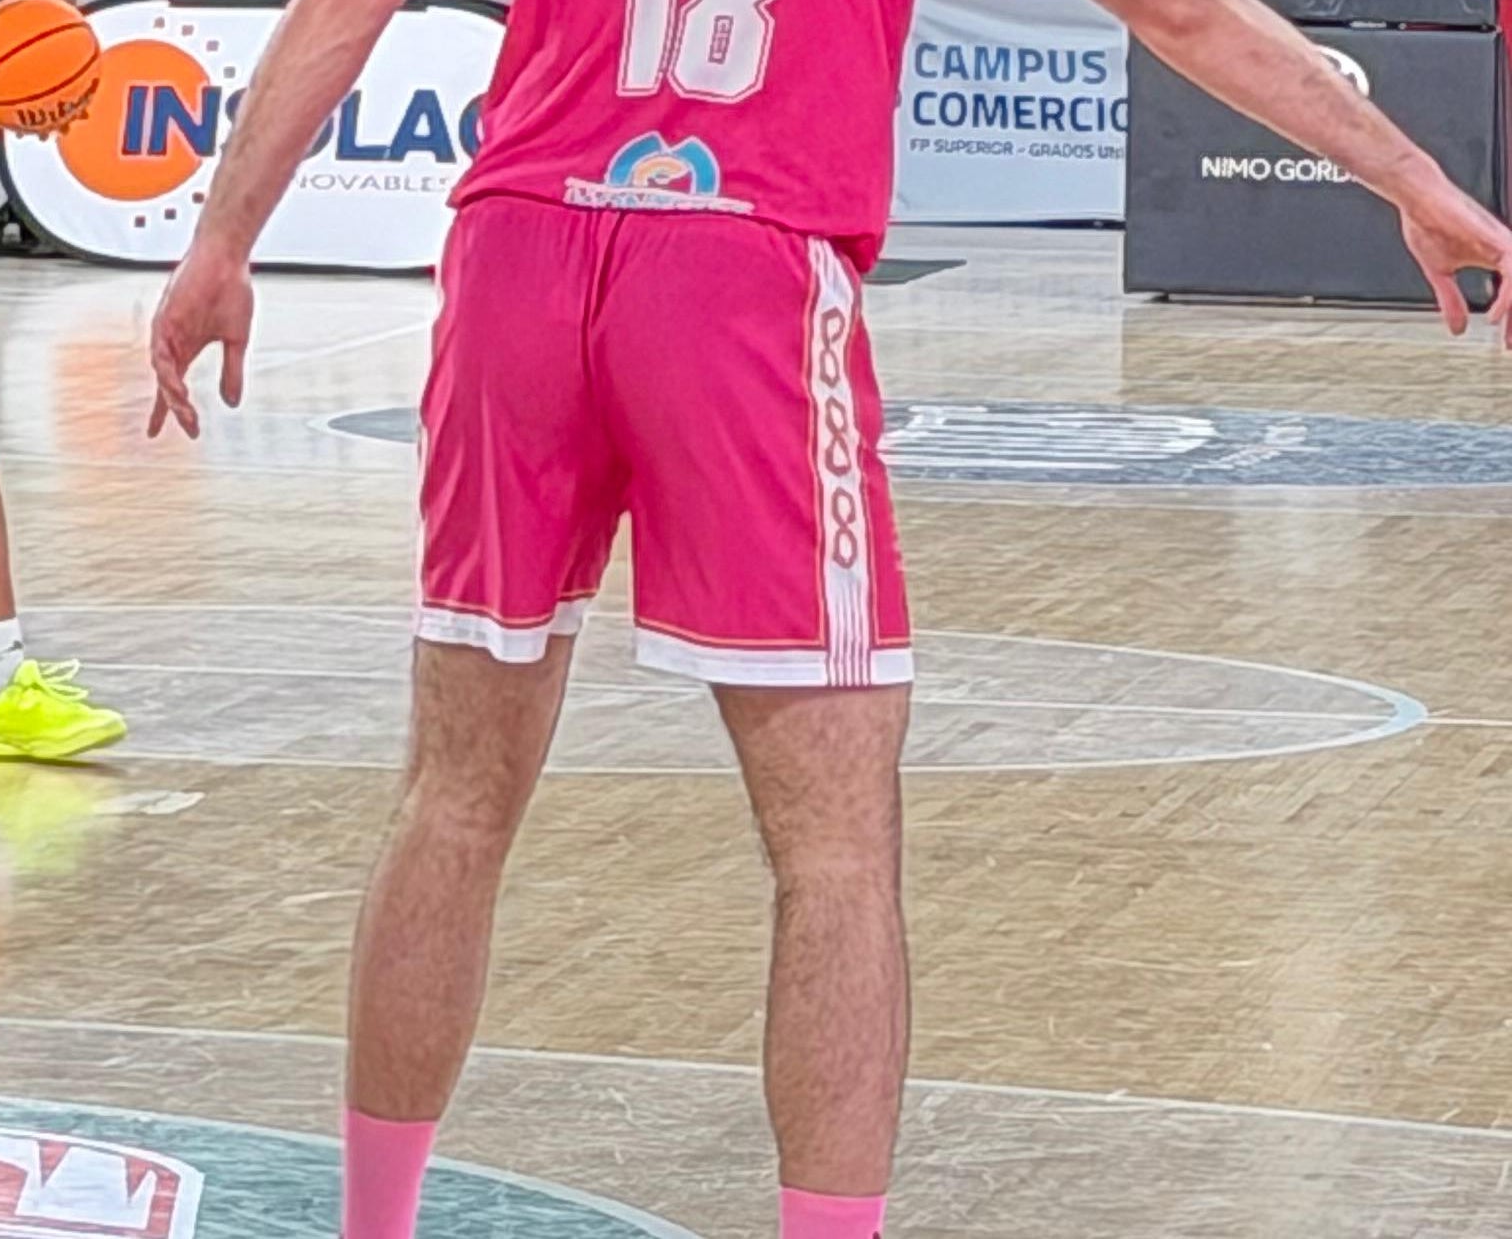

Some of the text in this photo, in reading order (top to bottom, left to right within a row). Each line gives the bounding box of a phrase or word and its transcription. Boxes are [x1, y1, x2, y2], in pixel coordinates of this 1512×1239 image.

[915, 42, 1107, 85] CAMPUS
[913, 90, 1129, 132] COMERCIO
[909, 139, 930, 151] FP
[933, 139, 1014, 155] SUPERIOR
[1028, 142, 1095, 158] GRADOS
[1201, 156, 1354, 183] NIMO GORD
